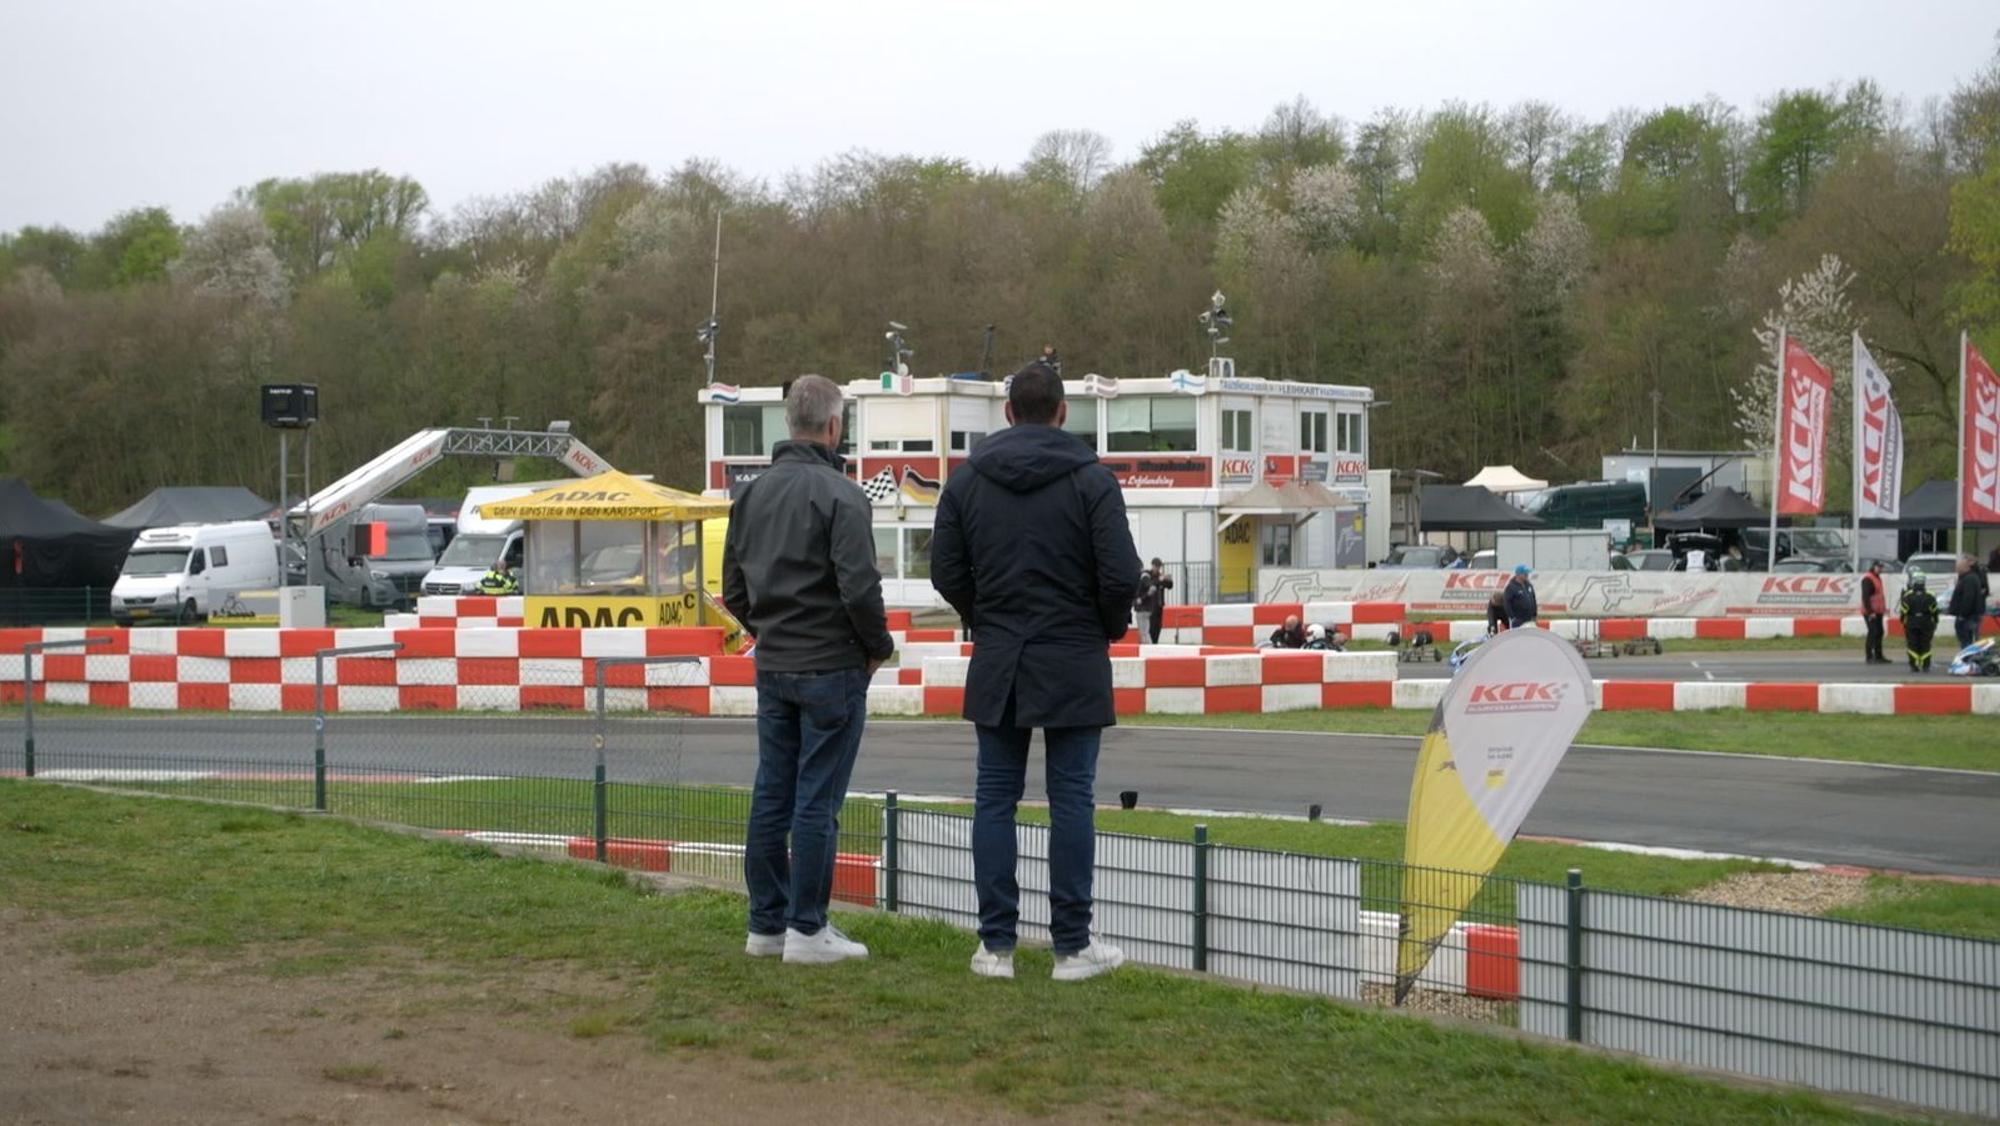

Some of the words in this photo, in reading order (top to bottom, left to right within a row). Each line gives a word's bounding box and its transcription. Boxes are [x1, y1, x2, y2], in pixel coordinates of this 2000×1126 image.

[1789, 380, 1812, 503] KCK
[1862, 384, 1888, 505] KCK
[1973, 386, 1998, 511] KCK
[572, 450, 595, 472] KCK
[1221, 459, 1250, 474] KCK
[1336, 459, 1362, 474] KCK
[543, 491, 630, 501] ADAC
[494, 507, 518, 516] DEIN
[519, 507, 564, 516] EINSTIEG
[565, 507, 577, 516] IN
[579, 507, 600, 516] DEN
[602, 507, 659, 516] KARTSPORT
[1224, 522, 1249, 545] ADAC
[1761, 576, 1847, 593] KCK
[659, 602, 683, 627] ADAC
[1470, 683, 1557, 703] KCK
